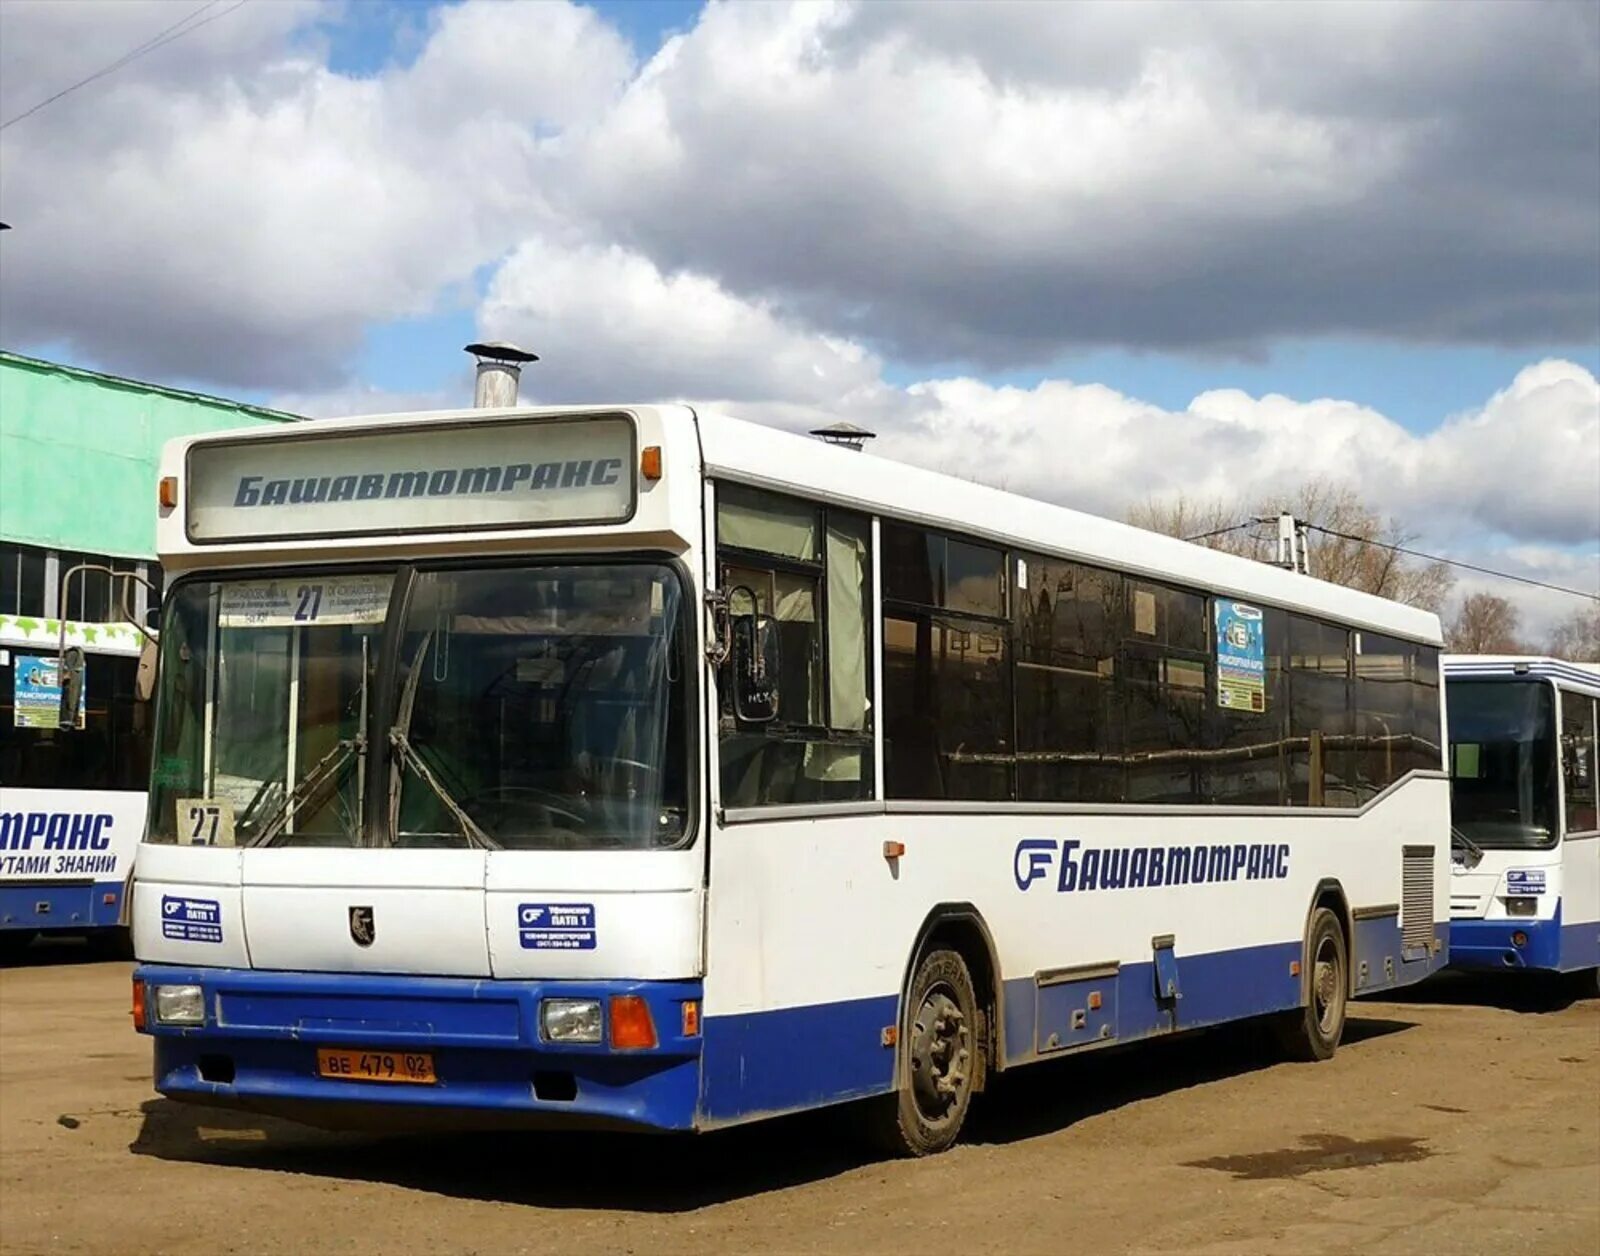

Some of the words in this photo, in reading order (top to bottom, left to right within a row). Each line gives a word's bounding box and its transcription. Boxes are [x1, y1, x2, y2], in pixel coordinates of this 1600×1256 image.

[294, 585, 323, 621] 27
[189, 807, 220, 846] 27
[54, 853, 117, 873] ЗНАНИЙ
[552, 916, 578, 925] ПАТП
[582, 916, 586, 925] 1
[360, 1054, 395, 1077] 479
[405, 1055, 427, 1073] 02
